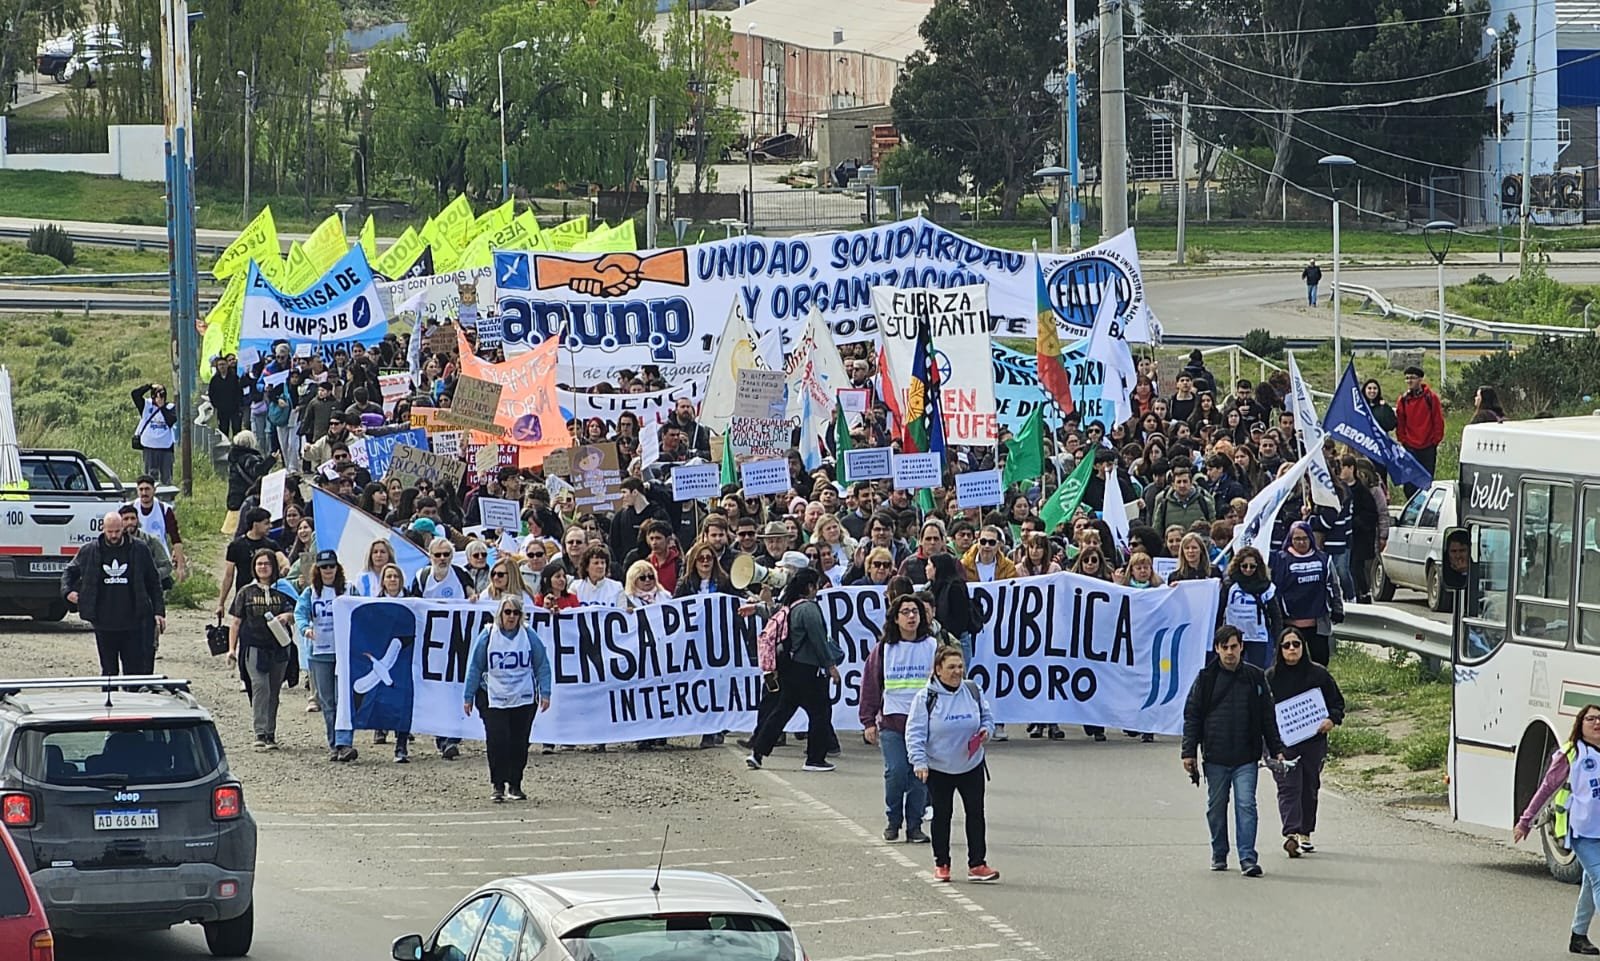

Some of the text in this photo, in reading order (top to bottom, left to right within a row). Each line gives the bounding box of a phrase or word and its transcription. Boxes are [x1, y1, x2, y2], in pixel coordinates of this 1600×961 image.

[697, 240, 817, 281] UNIDAD,
[830, 224, 1024, 274] SOLIDARIDAD
[335, 267, 361, 292] DE
[407, 278, 427, 290] CON
[430, 271, 467, 285] TODAS
[471, 266, 492, 278] LAS
[741, 284, 762, 321] Y
[892, 292, 971, 316] FUERZA
[262, 310, 349, 337] LA UNPSJB
[400, 446, 413, 460] SI
[420, 452, 437, 468] NO
[440, 457, 462, 475] HAY
[745, 466, 786, 476] PRESUPUESTO
[675, 472, 716, 480] PRESUPUESTO
[959, 479, 999, 488] PRESUPUESTO
[1470, 471, 1515, 511] bello
[6, 510, 24, 526] 100
[666, 581, 1135, 674] LA PÚBLICA
[422, 609, 475, 683] EN
[661, 600, 698, 636] DE
[114, 791, 140, 802] Jeep
[98, 815, 155, 828] AD 686 AN
